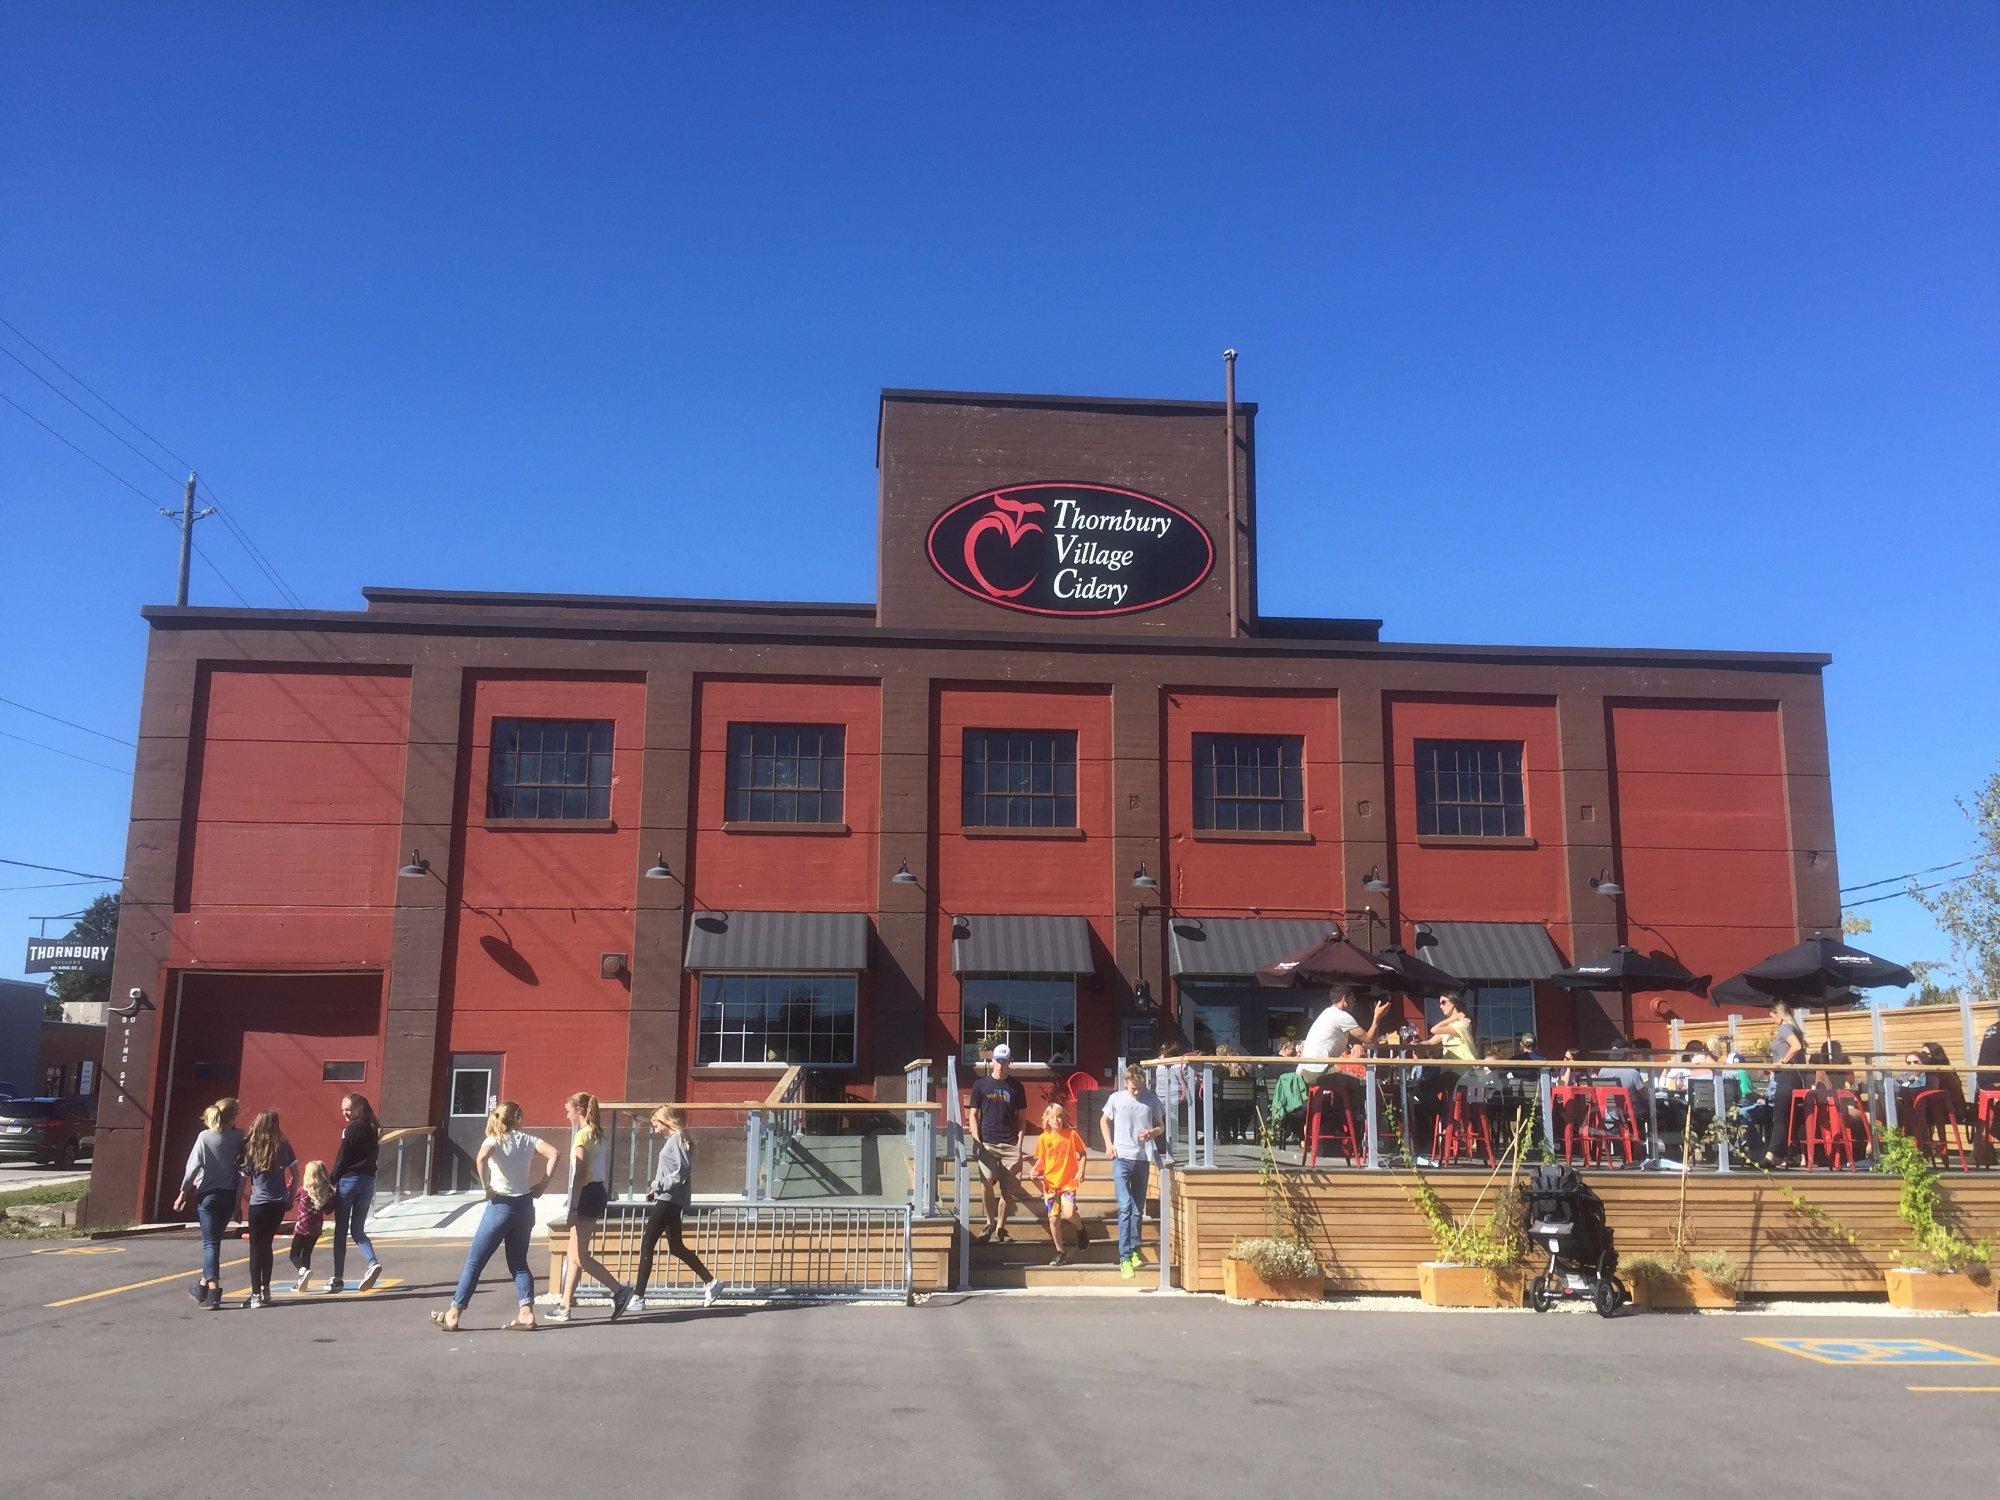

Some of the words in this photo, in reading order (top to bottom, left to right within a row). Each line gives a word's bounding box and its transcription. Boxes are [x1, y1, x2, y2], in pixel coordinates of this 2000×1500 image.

[1053, 499, 1171, 538] Thornbury
[1054, 534, 1134, 571] Village
[1053, 568, 1128, 605] Cidery
[30, 946, 109, 961] THORNBURY
[119, 1071, 126, 1087] ST
